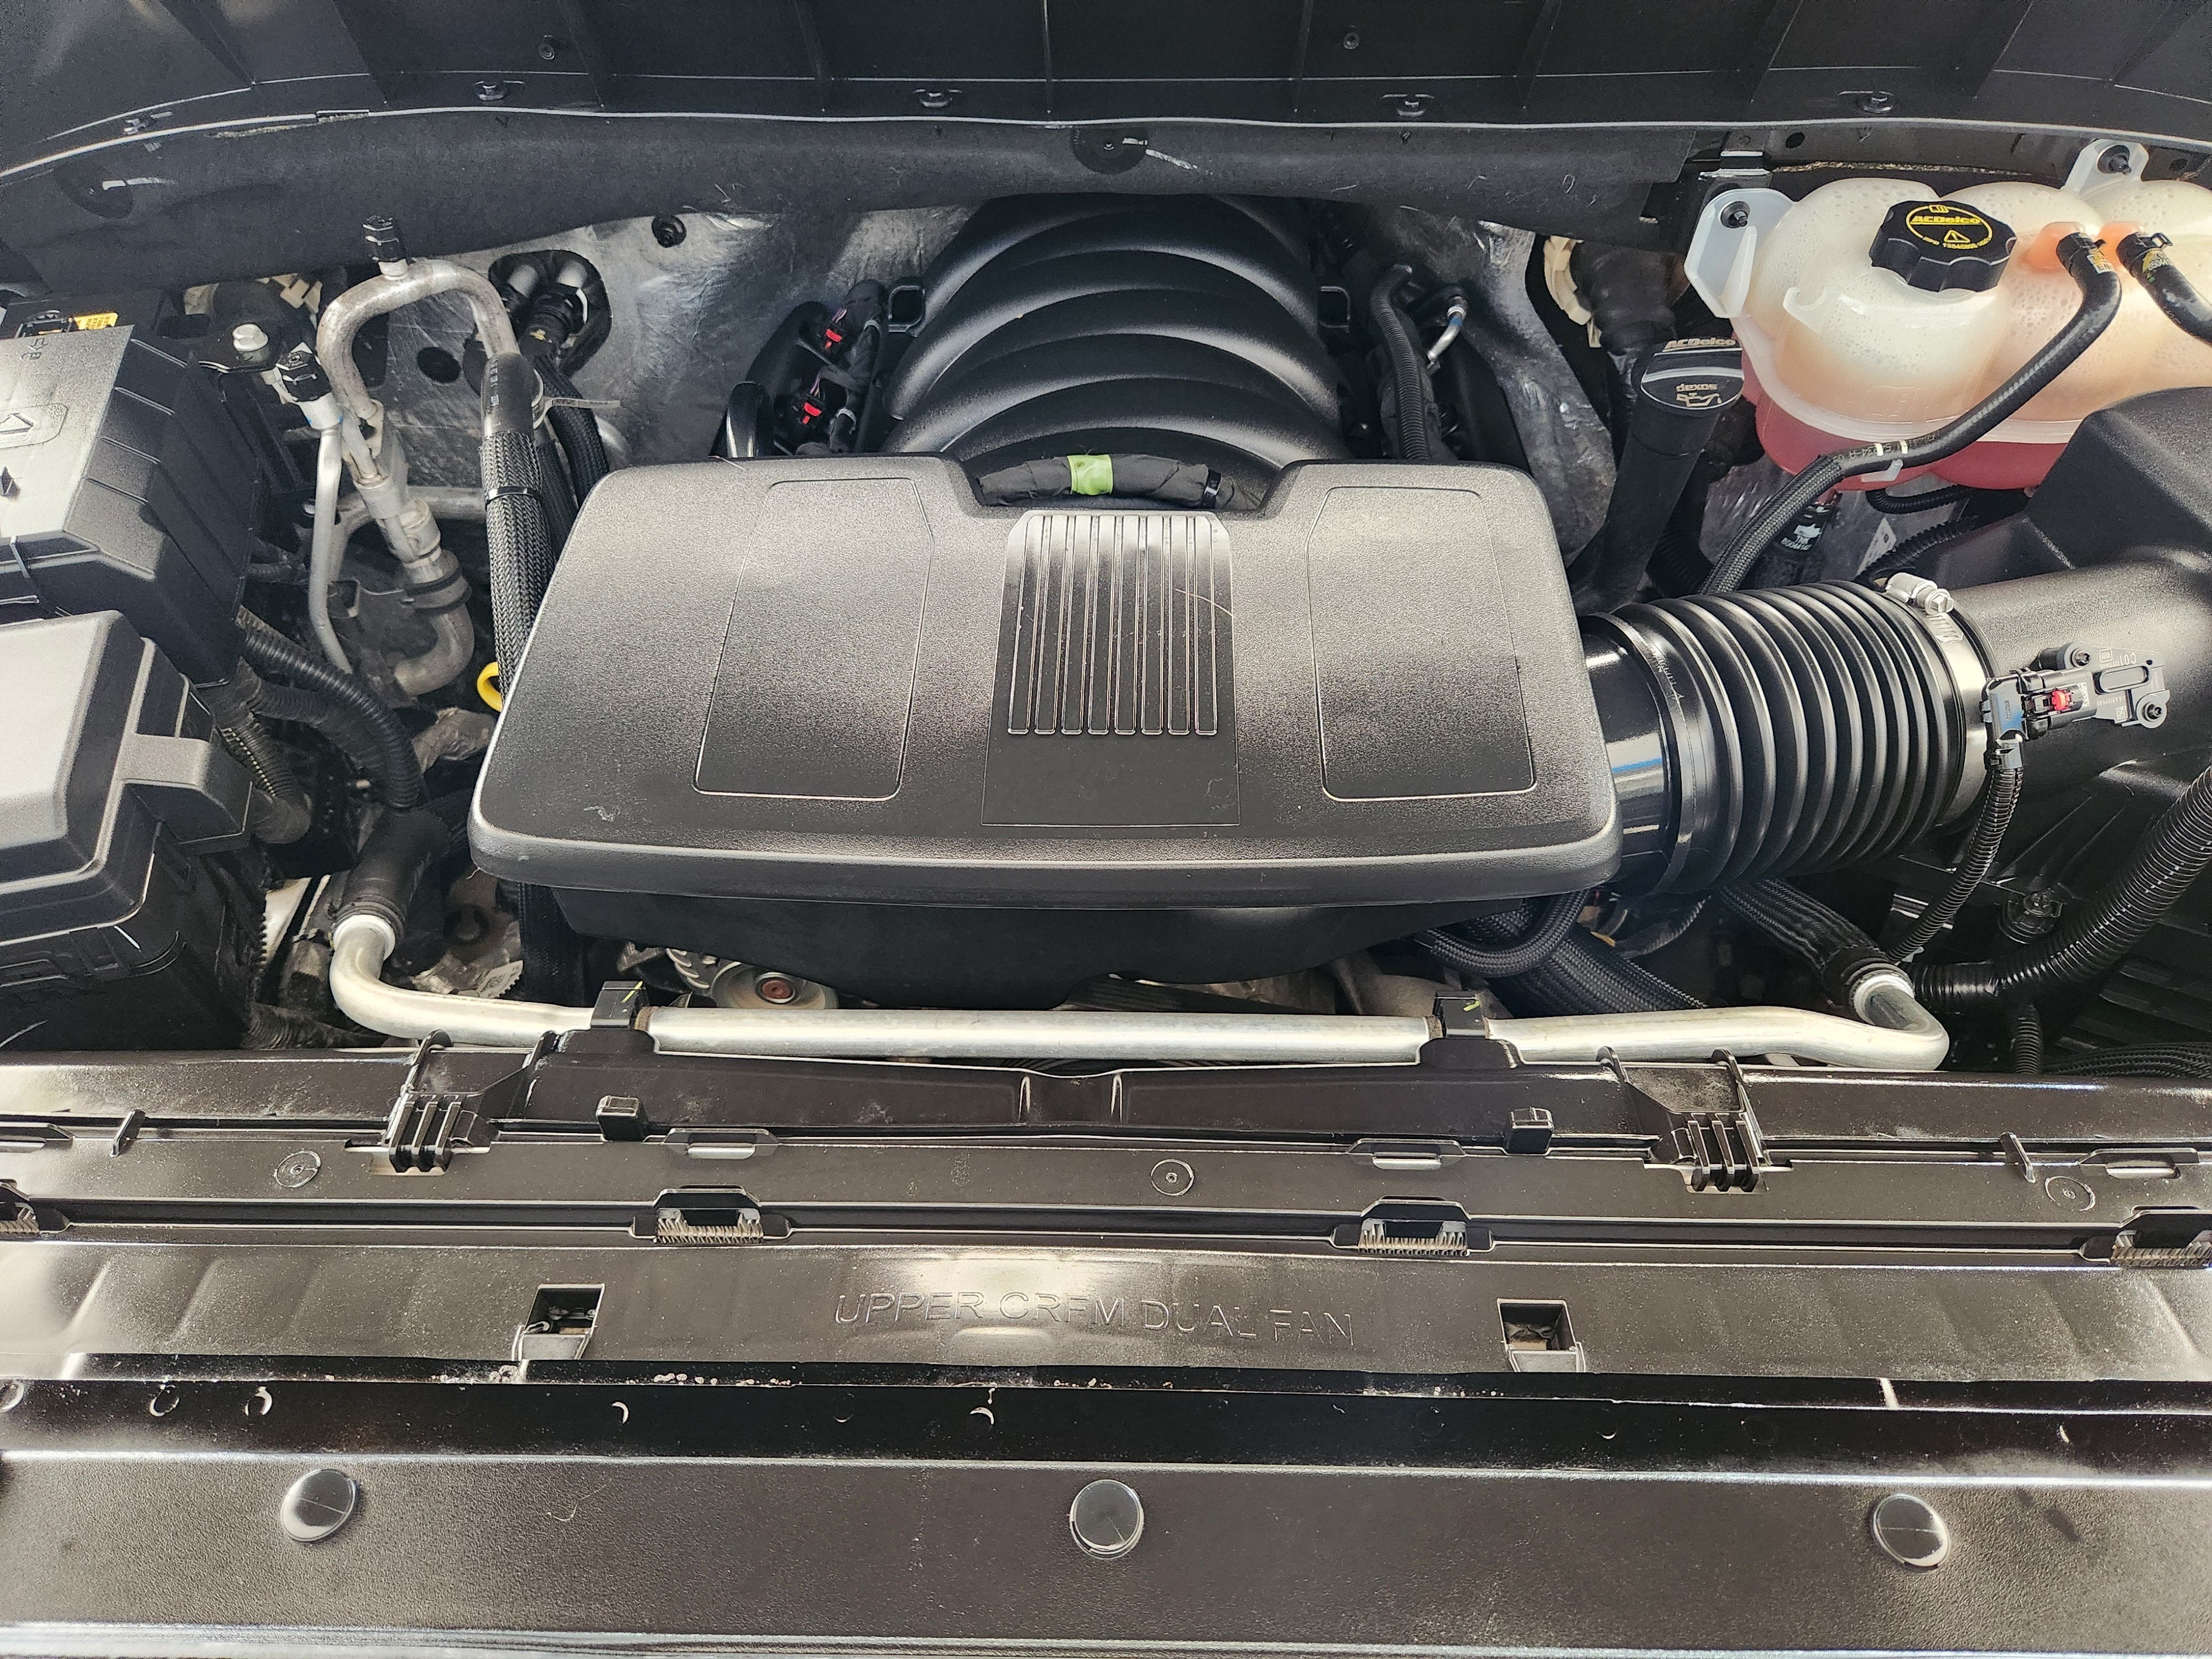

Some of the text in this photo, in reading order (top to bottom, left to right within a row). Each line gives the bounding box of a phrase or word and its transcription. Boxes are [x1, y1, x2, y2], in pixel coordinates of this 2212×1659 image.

[1912, 215, 1981, 223] ACDelco
[1664, 338, 1736, 349] ACDelco
[1676, 383, 1718, 392] dexos
[834, 1292, 1354, 1346] UPPER CRFM DUAL FAN
